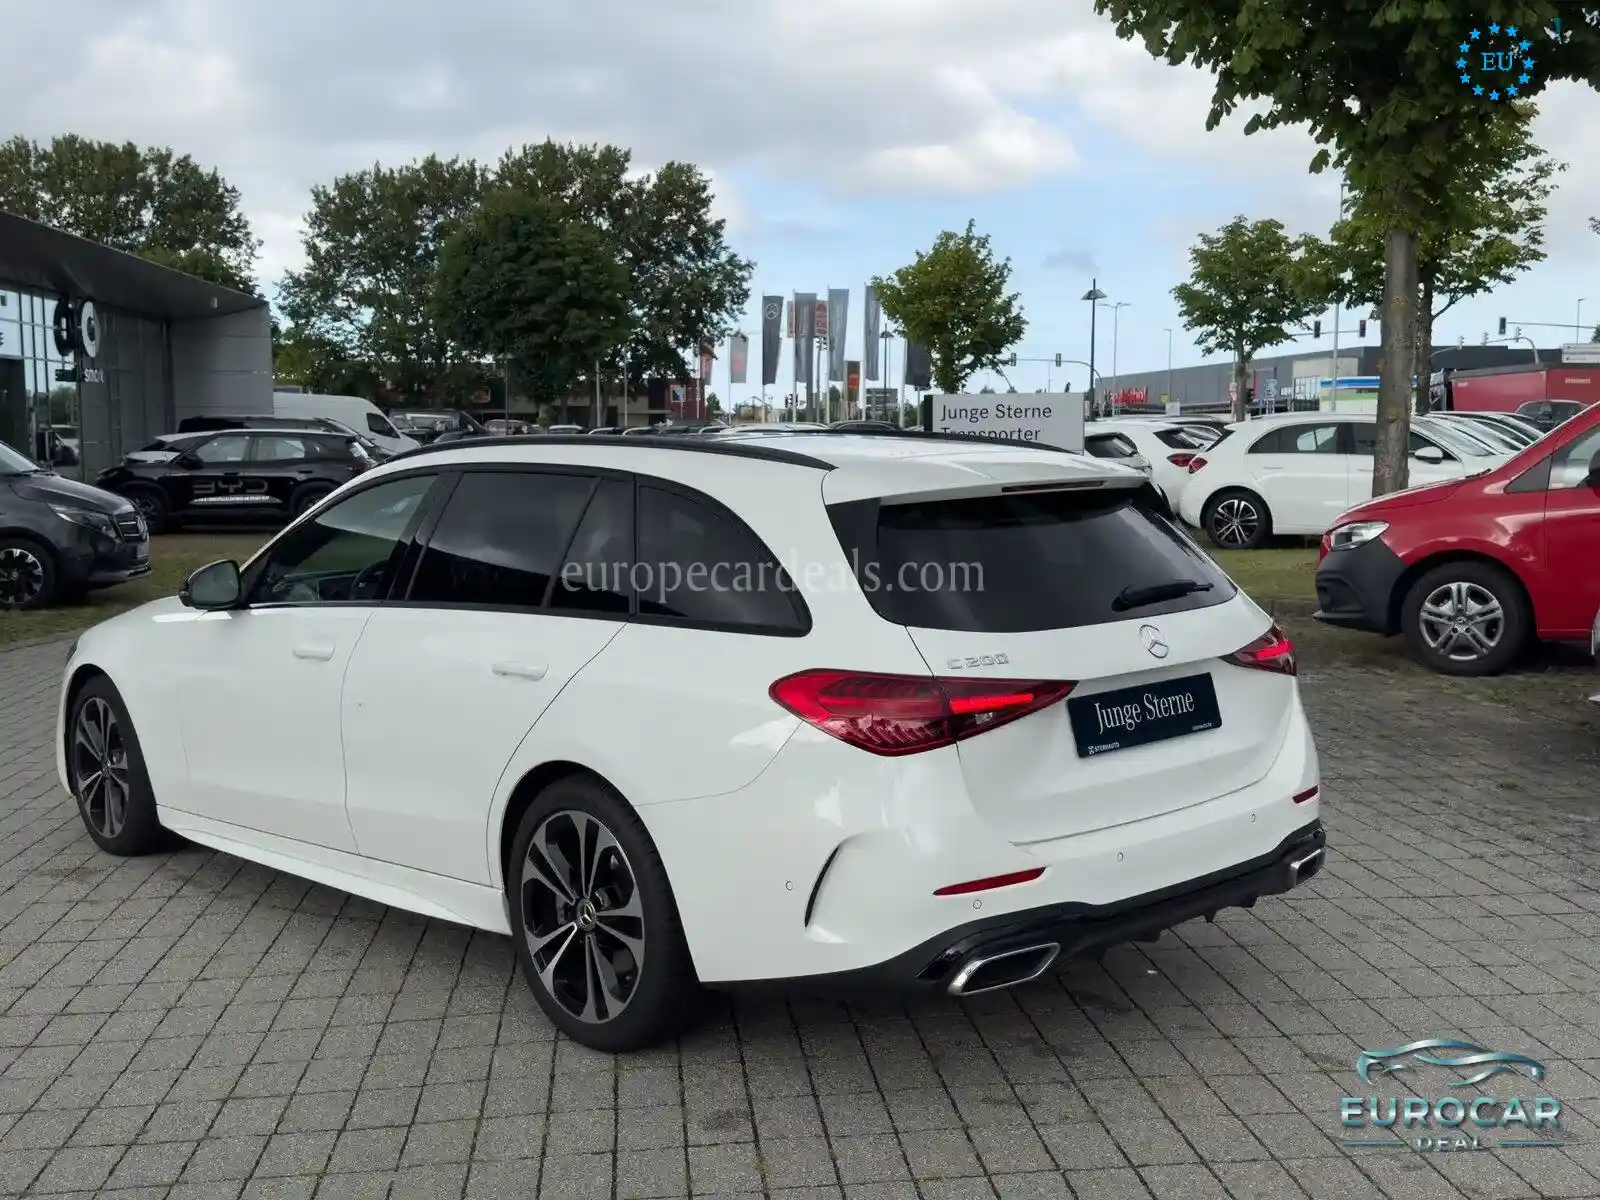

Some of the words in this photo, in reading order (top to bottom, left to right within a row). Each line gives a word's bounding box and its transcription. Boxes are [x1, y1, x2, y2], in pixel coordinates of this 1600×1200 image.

[940, 404, 989, 423] Junge
[995, 403, 1052, 419] Sterne
[940, 427, 1041, 441] Tnsporter
[946, 657, 963, 669] C
[964, 652, 1009, 668] 200
[1094, 702, 1141, 734] Junge
[1143, 692, 1195, 720] Sterne
